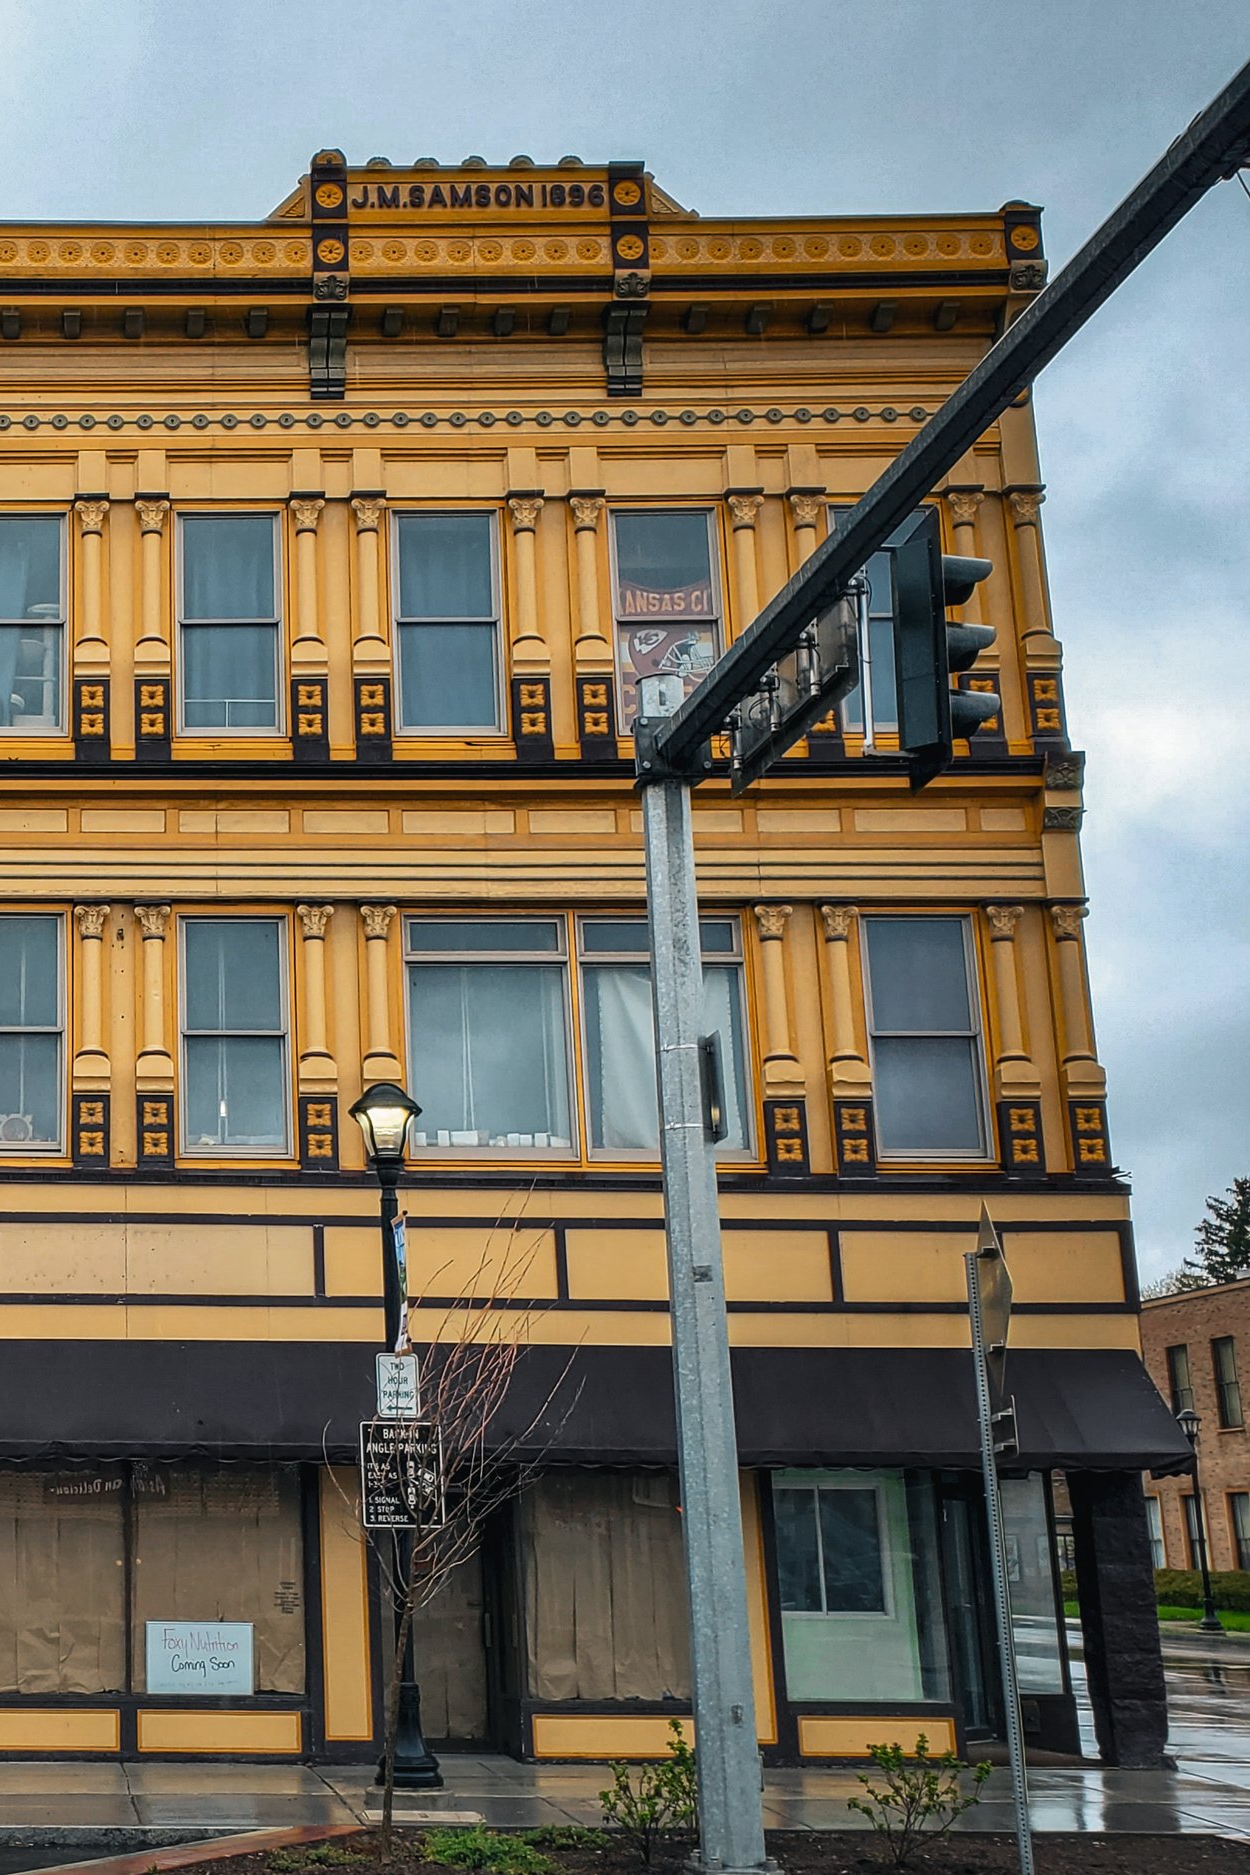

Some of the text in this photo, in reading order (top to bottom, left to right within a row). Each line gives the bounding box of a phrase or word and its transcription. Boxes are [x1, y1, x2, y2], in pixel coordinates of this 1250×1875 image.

[541, 184, 605, 208] 1896
[387, 1376, 408, 1385] HOUR
[366, 1443, 395, 1454] ANGLE
[374, 1496, 400, 1504] SIGNAL
[162, 1628, 239, 1658] Foxy Nutrition
[171, 1654, 235, 1678] Coming Soon
